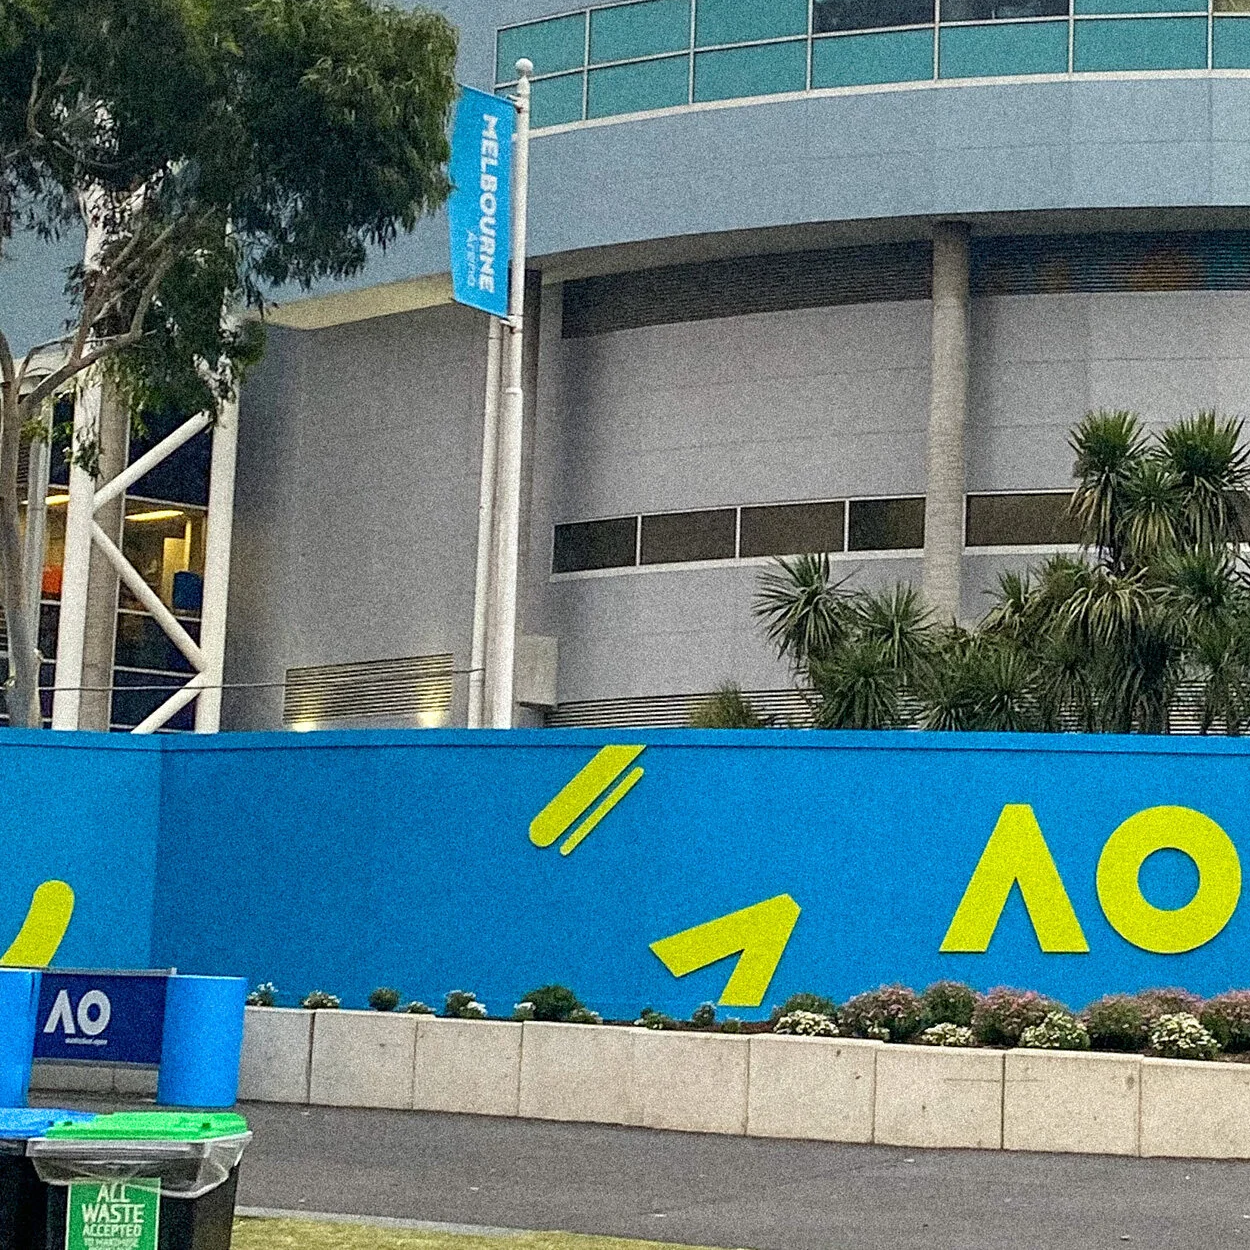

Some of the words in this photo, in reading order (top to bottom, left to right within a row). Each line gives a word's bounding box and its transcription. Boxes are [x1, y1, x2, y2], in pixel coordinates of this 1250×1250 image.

[479, 113, 499, 293] MELBOURNE
[939, 804, 1242, 954] AO
[43, 989, 111, 1036] AO
[97, 1181, 130, 1203] ALL
[81, 1203, 145, 1223] WASTE
[82, 1223, 142, 1237] ACCEPTED
